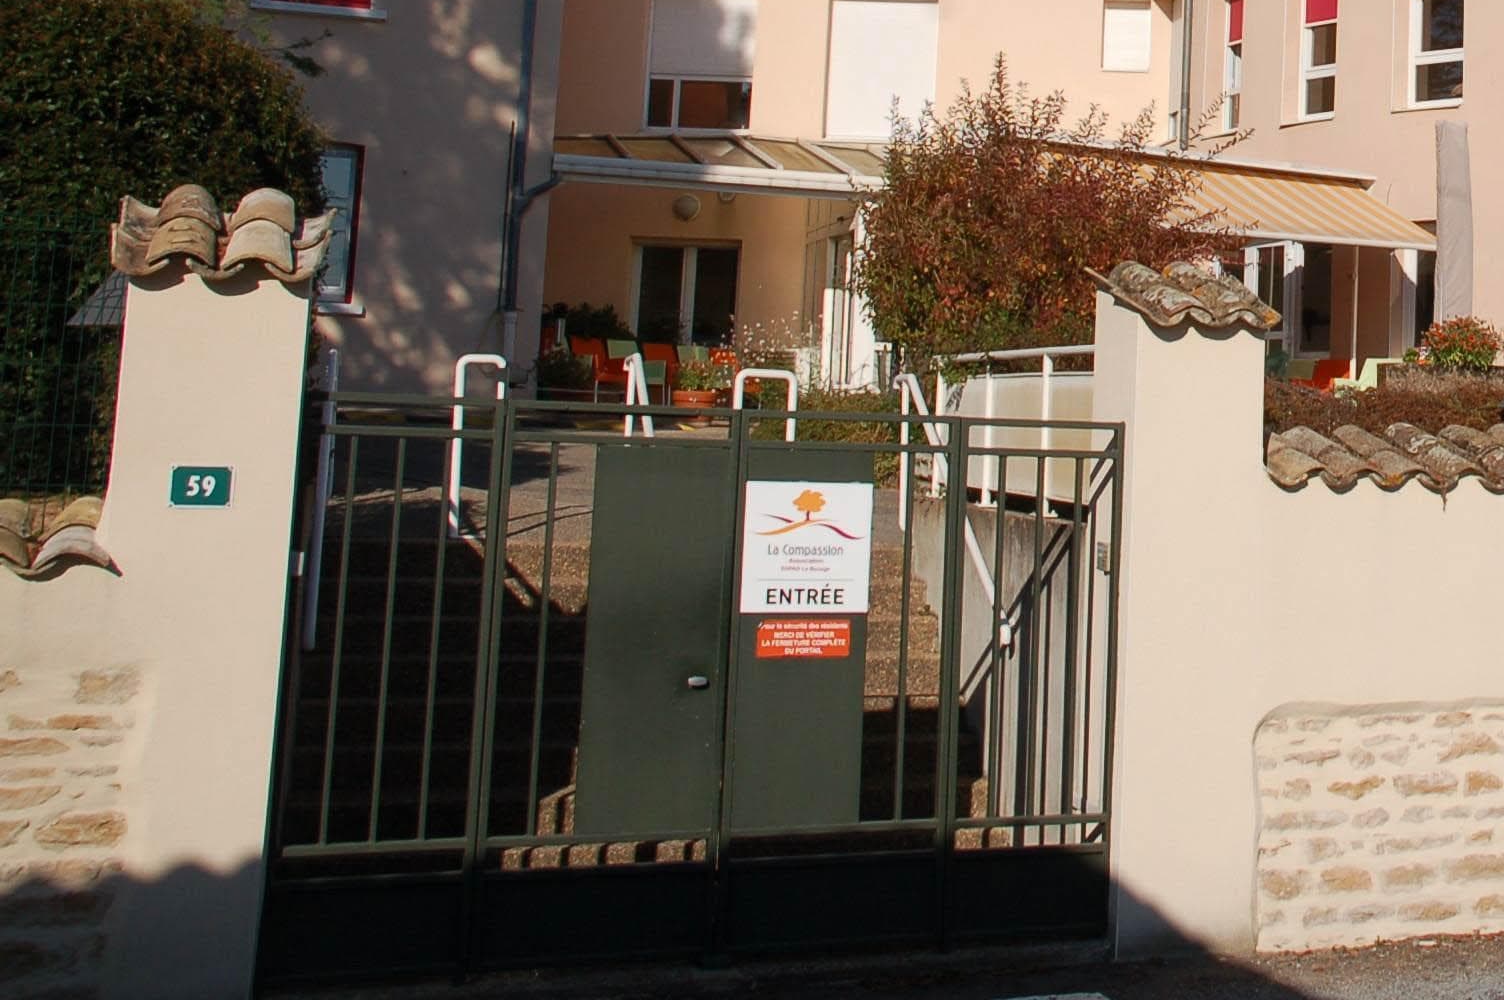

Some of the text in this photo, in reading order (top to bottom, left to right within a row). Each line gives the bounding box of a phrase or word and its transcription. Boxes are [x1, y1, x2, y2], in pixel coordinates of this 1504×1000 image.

[186, 475, 216, 497] 59
[768, 544, 843, 557] La Compassion
[767, 583, 844, 604] ENTRÉE
